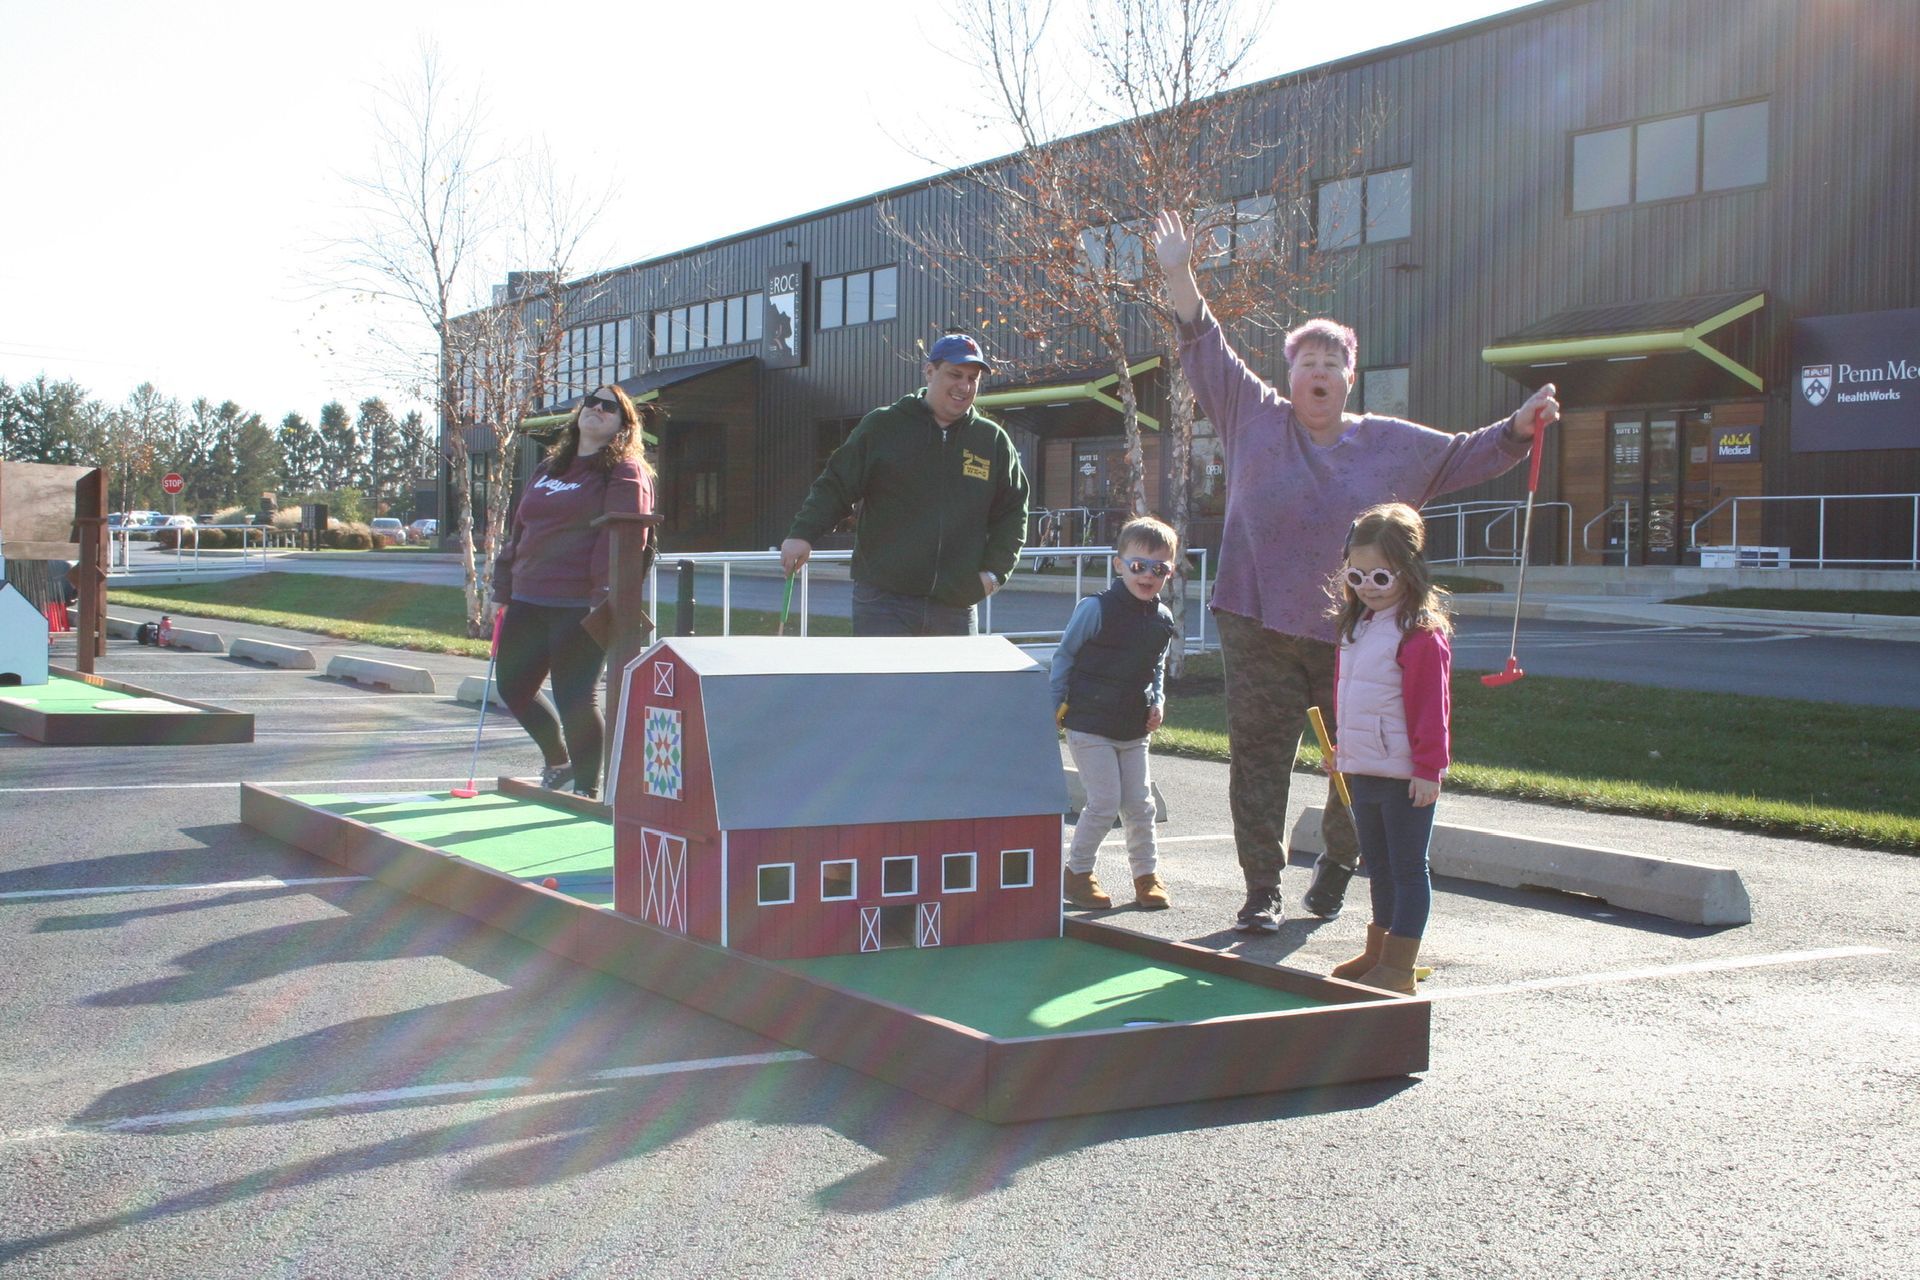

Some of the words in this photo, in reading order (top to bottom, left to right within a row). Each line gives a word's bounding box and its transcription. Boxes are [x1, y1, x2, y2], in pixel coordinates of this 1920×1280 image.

[774, 273, 795, 294] ROC
[1838, 363, 1884, 384] Penn
[1886, 359, 1920, 380] Me
[1837, 388, 1901, 403] HealthWorks
[1719, 445, 1751, 456] Medical
[164, 479, 182, 488] STOP
